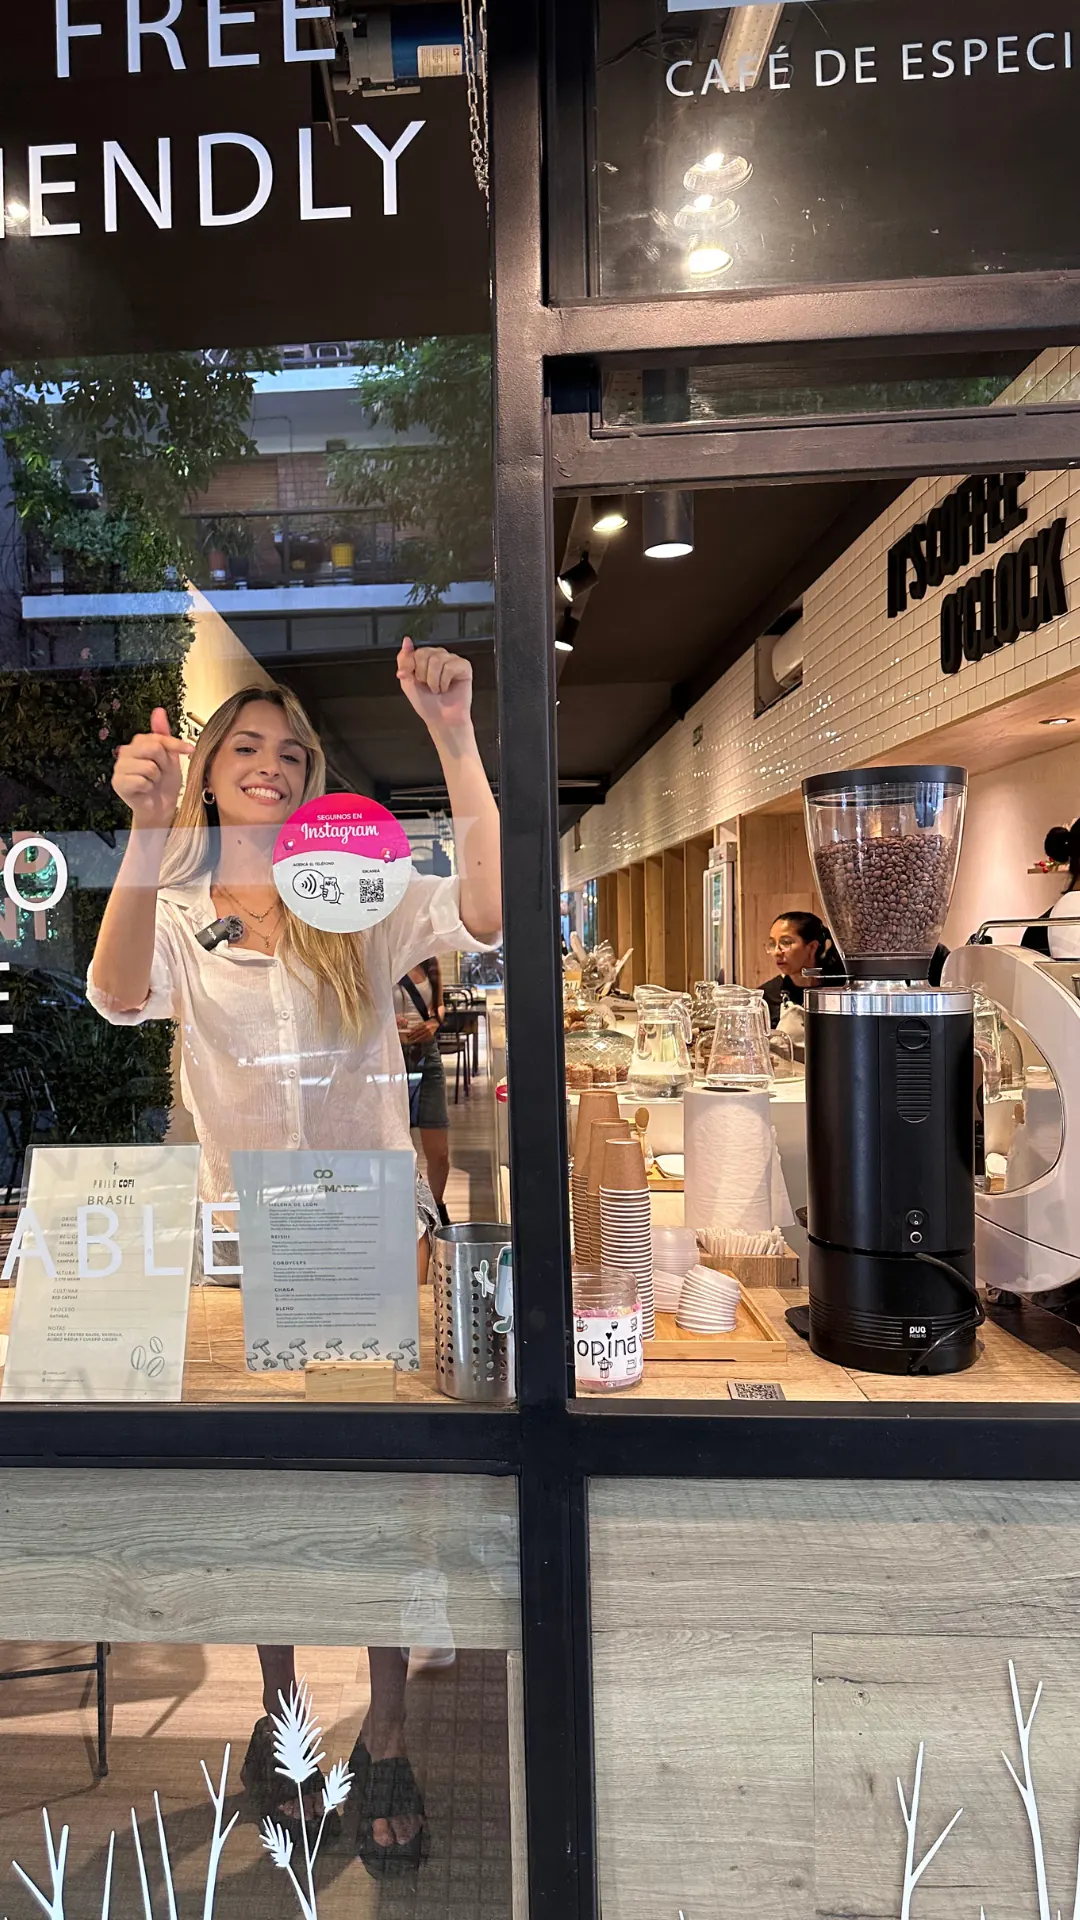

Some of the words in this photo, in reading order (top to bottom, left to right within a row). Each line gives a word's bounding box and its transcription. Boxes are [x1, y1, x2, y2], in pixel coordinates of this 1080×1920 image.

[55, 0, 336, 78] FREE
[665, 50, 791, 98] CAFÉ
[815, 46, 877, 87] DE
[902, 32, 1072, 81] ESPECI
[926, 472, 1029, 587] COFFEE
[940, 517, 1069, 675] O'CLOCK
[300, 822, 379, 844] Instagram
[316, 813, 352, 821] SEGUINOS
[4, 838, 68, 912] O
[87, 1194, 136, 1206] BRASIL
[118, 1179, 135, 1188] COFI
[317, 1184, 358, 1193] SMART
[0, 1202, 243, 1280] ABLE
